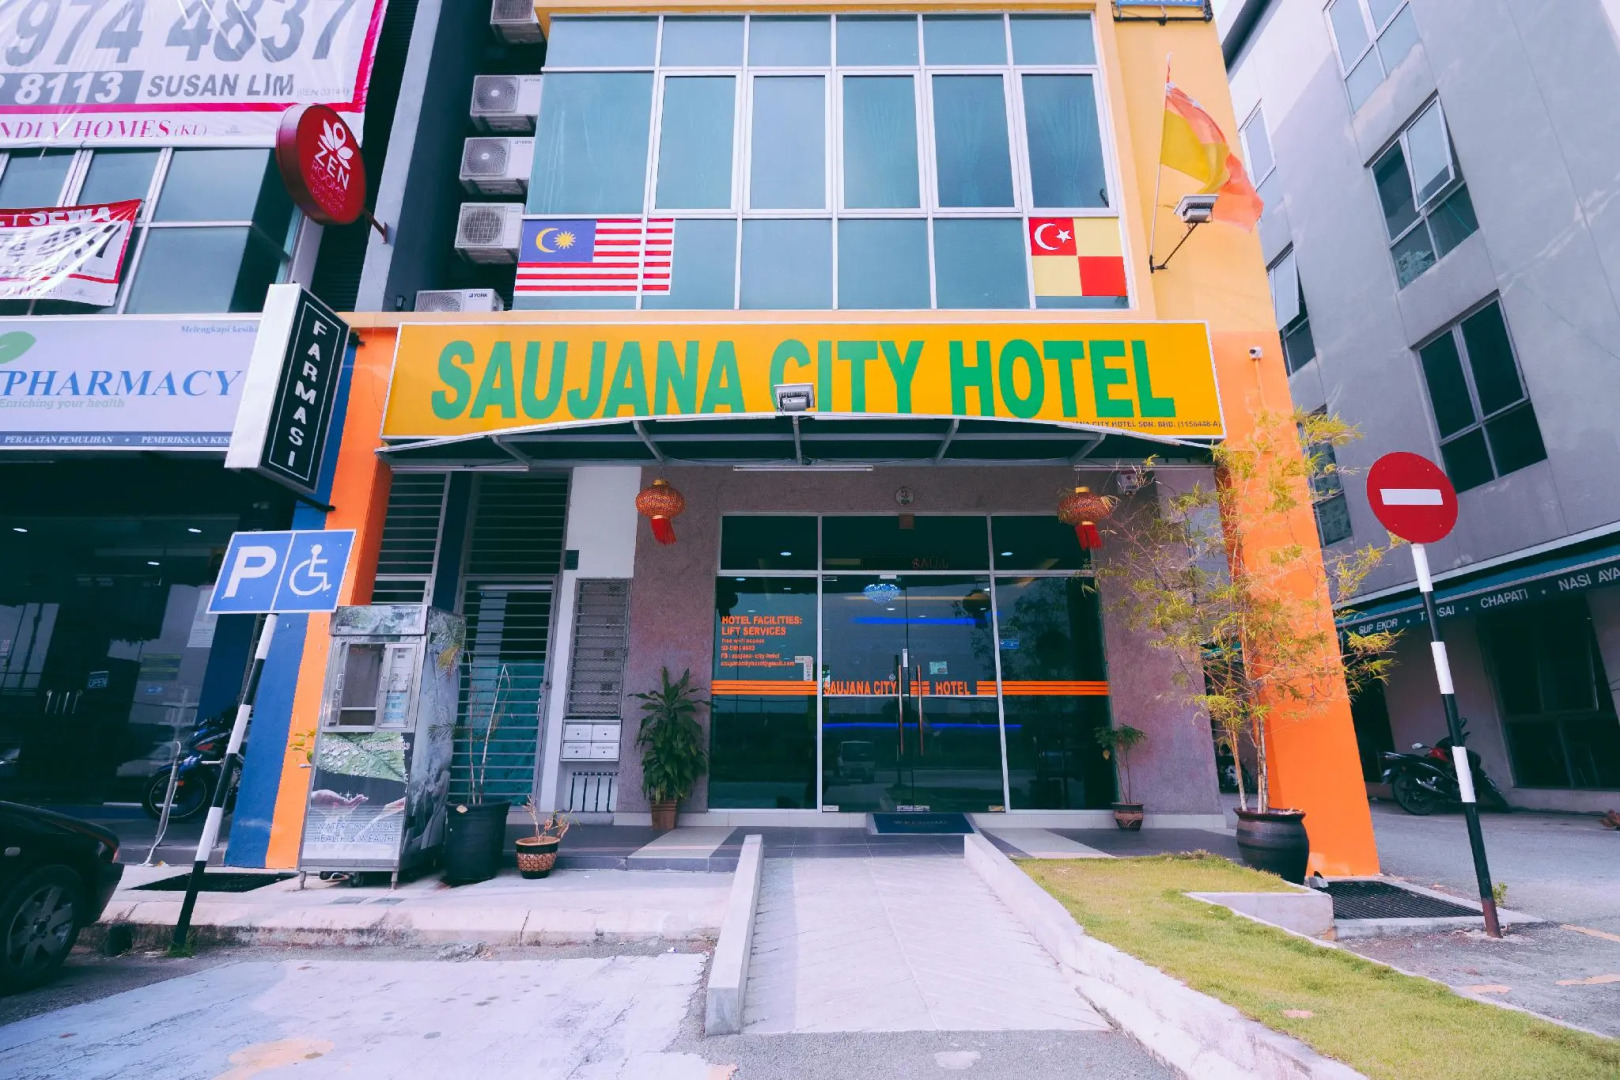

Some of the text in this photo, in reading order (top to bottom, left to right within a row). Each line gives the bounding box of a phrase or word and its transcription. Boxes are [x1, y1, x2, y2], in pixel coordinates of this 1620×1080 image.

[15, 72, 123, 104] 8113
[147, 74, 239, 97] SUSAN
[247, 73, 294, 97] LIM
[73, 120, 171, 138] HOMES
[315, 141, 349, 190] ZEN
[0, 370, 243, 396] PHARMACY
[431, 339, 1177, 420] SAUJANA CITY HOTEL
[57, 401, 84, 409] your
[86, 399, 125, 408] health
[287, 320, 328, 467] FARMASI
[5, 435, 58, 443] PERALATAN
[59, 435, 113, 443] PEMULIHAN
[141, 436, 210, 444] PEMERIKSAAN
[224, 546, 277, 597] P
[1359, 624, 1374, 635] SUP
[1376, 618, 1398, 631] EKOR
[1420, 605, 1455, 621] TSAI
[1480, 588, 1529, 608] CHAPATI
[1558, 573, 1592, 591] NASI
[721, 615, 803, 625] HOTEL FACILITIES:
[721, 627, 786, 636] LIFT SERVICES
[88, 677, 107, 688] OPEN
[823, 680, 971, 696] SAUJANA CITY HOTEL
[314, 834, 346, 842] HEALTH
